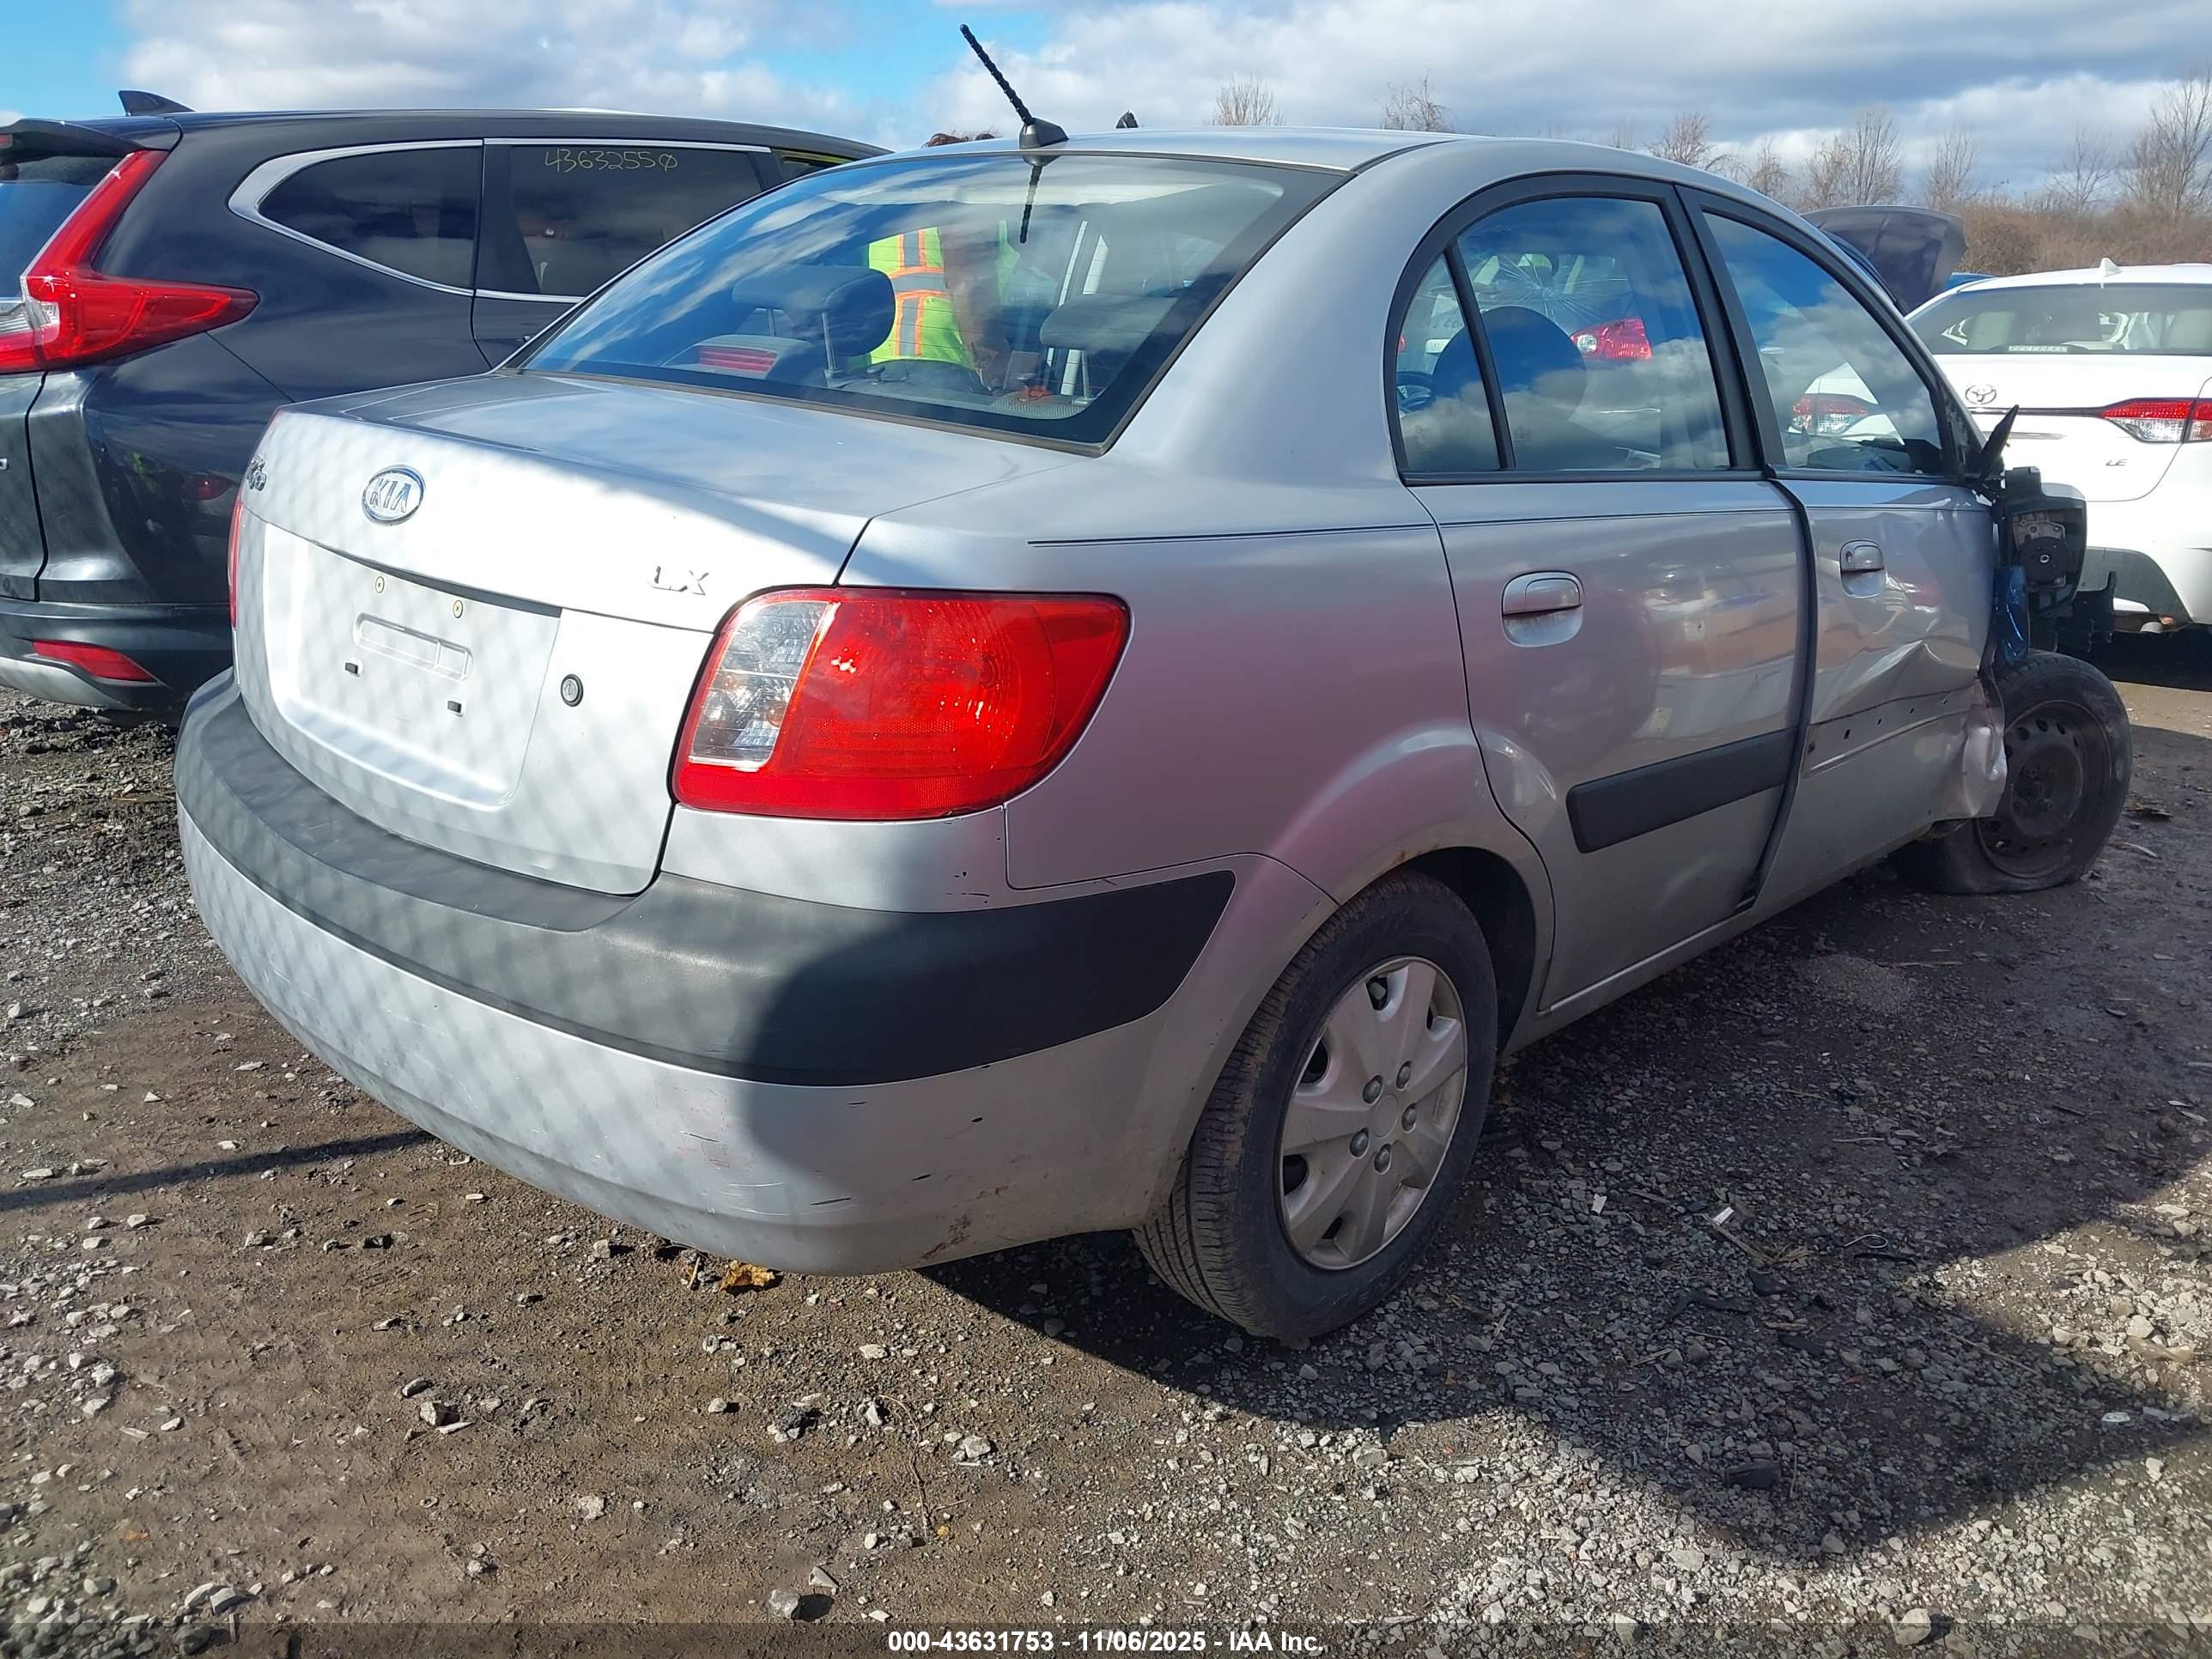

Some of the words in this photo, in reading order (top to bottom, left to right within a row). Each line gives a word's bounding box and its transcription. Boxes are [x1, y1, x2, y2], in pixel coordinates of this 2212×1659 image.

[2105, 459, 2129, 467] LE
[368, 477, 412, 514] KIA
[649, 564, 710, 596] LX
